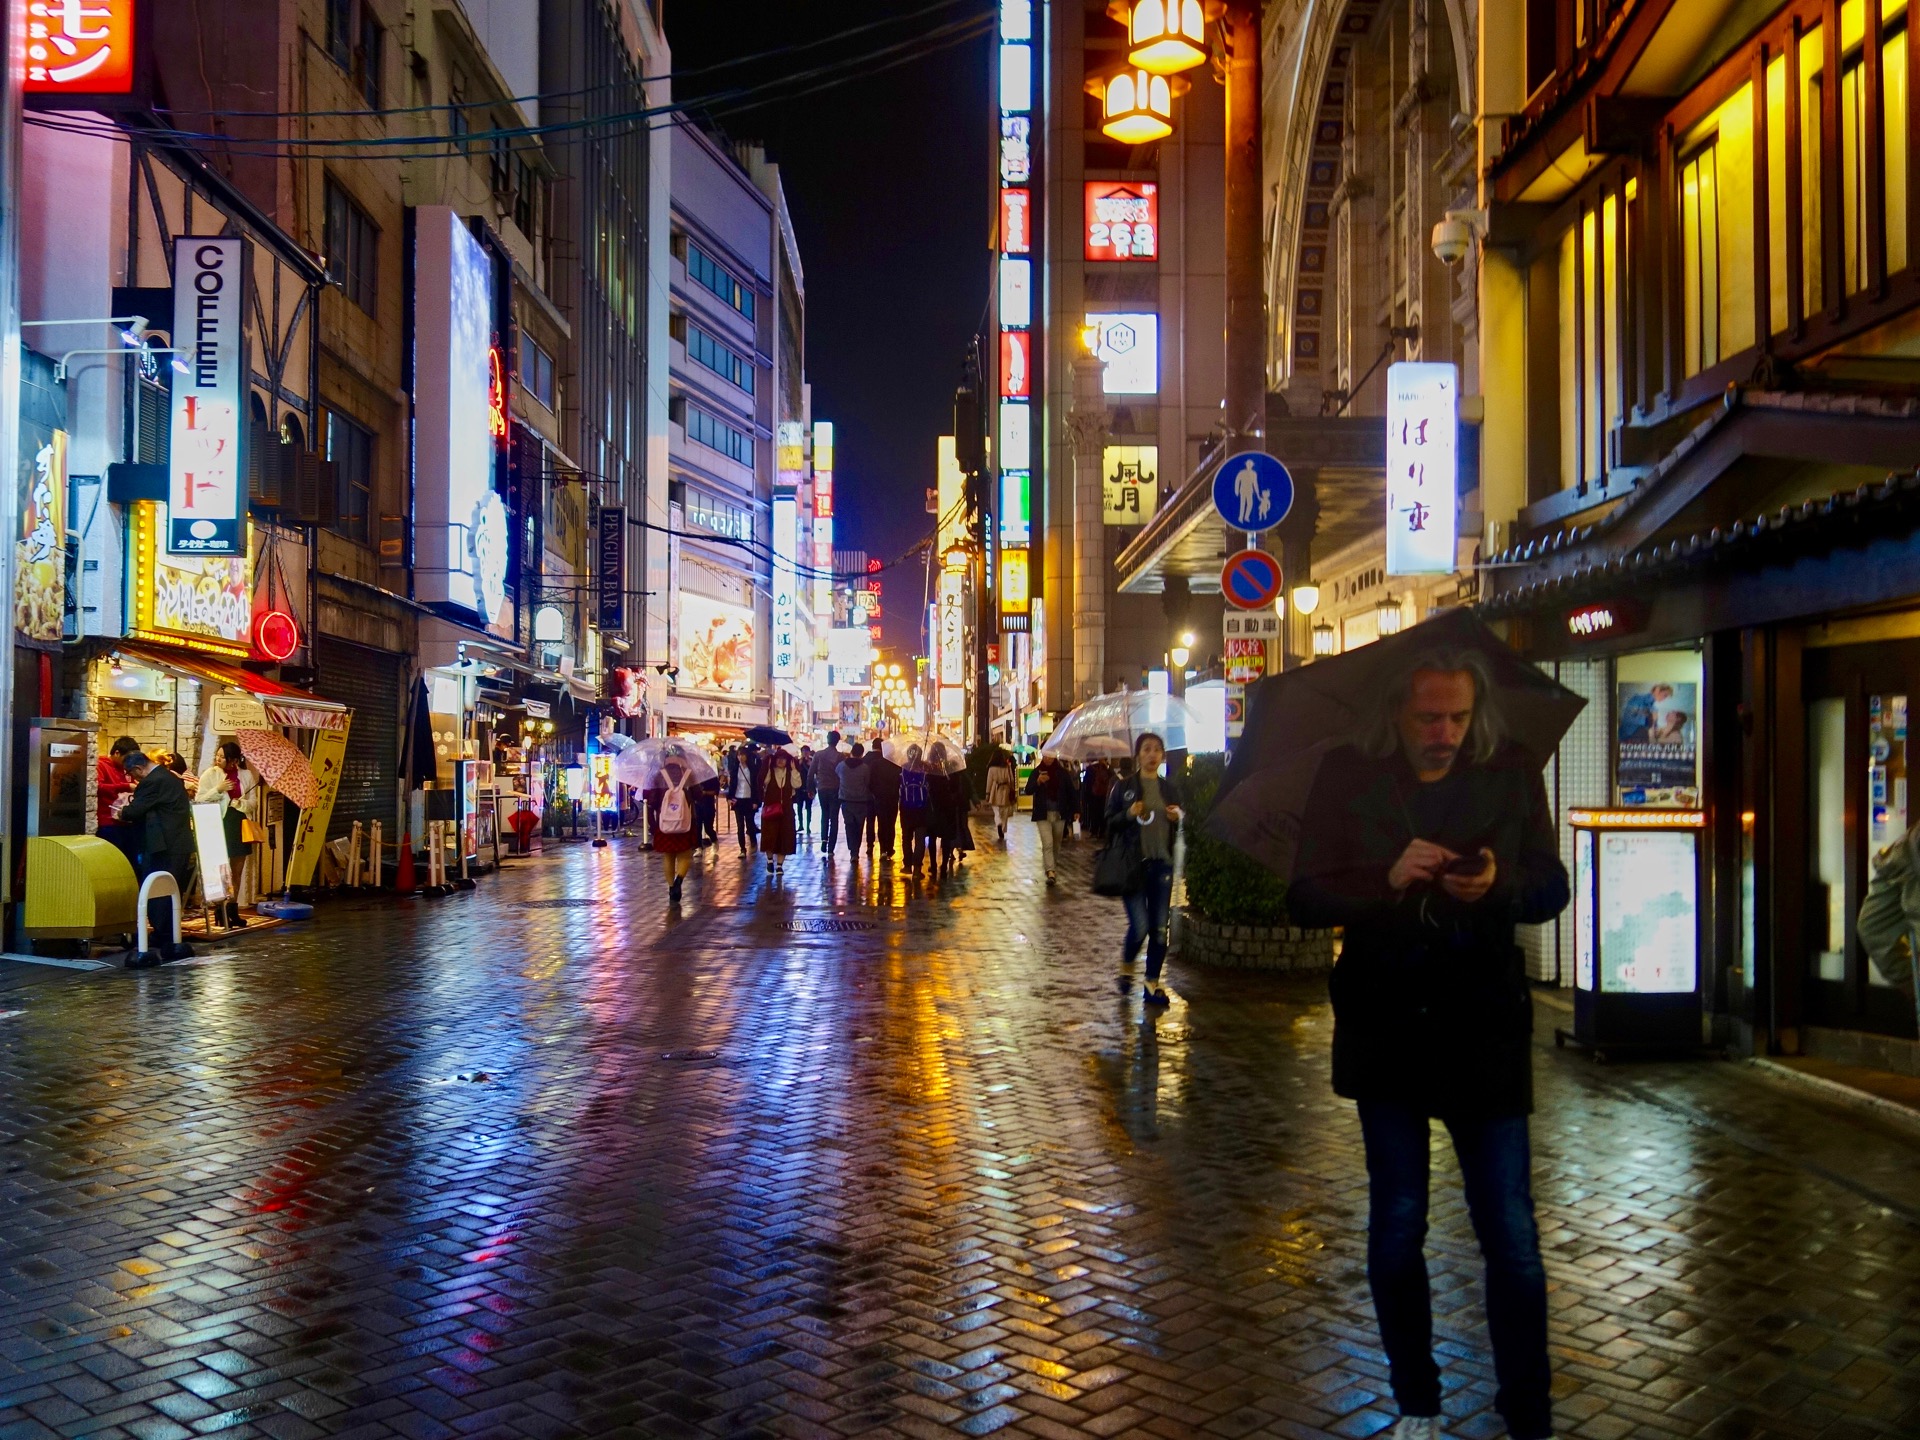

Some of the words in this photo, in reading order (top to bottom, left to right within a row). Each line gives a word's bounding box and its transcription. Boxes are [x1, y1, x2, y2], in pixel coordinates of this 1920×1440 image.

[1089, 223, 1154, 247] 268
[194, 245, 224, 388] COFFEE
[1110, 459, 1154, 514] 風月
[603, 514, 618, 576] PENGUIN
[603, 581, 618, 608] BAR
[1226, 618, 1277, 633] 自動車
